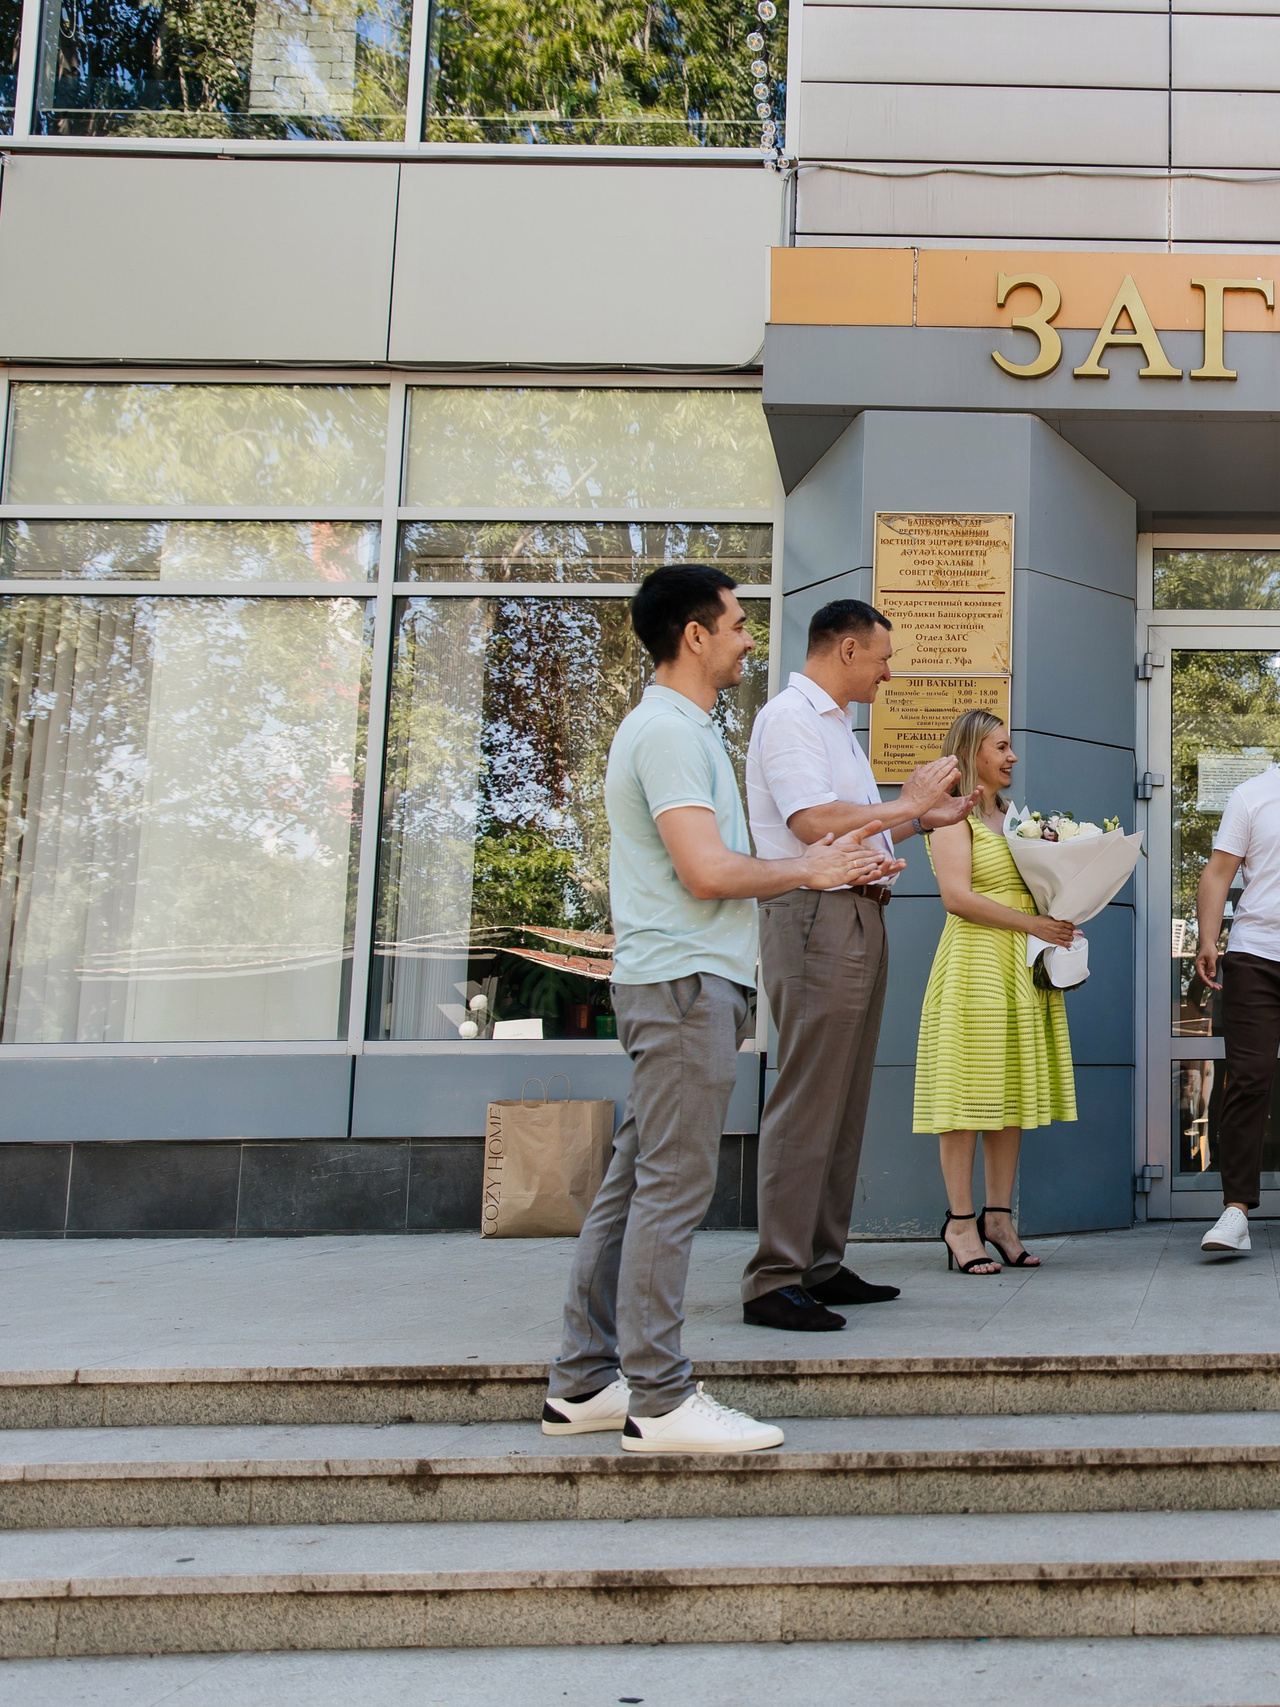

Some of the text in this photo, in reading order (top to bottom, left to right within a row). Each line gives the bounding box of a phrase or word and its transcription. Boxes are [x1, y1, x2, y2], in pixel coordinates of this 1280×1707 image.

[880, 538, 926, 546] ЮСТИЦИЯ
[938, 549, 987, 557] КОМИТЕТЫ
[883, 598, 962, 607] Государственный
[882, 610, 1003, 620] Республики Башкортостан
[915, 633, 969, 641] Отдел ЗАГС
[916, 645, 967, 653] Советского
[911, 657, 944, 666] района
[954, 657, 972, 666] Уфа
[906, 679, 923, 687] ЭШ
[897, 732, 936, 741] РЕЖИМ
[920, 743, 942, 751] суббот
[883, 751, 916, 759] Перерыв
[482, 1107, 504, 1236] COZY HOME
